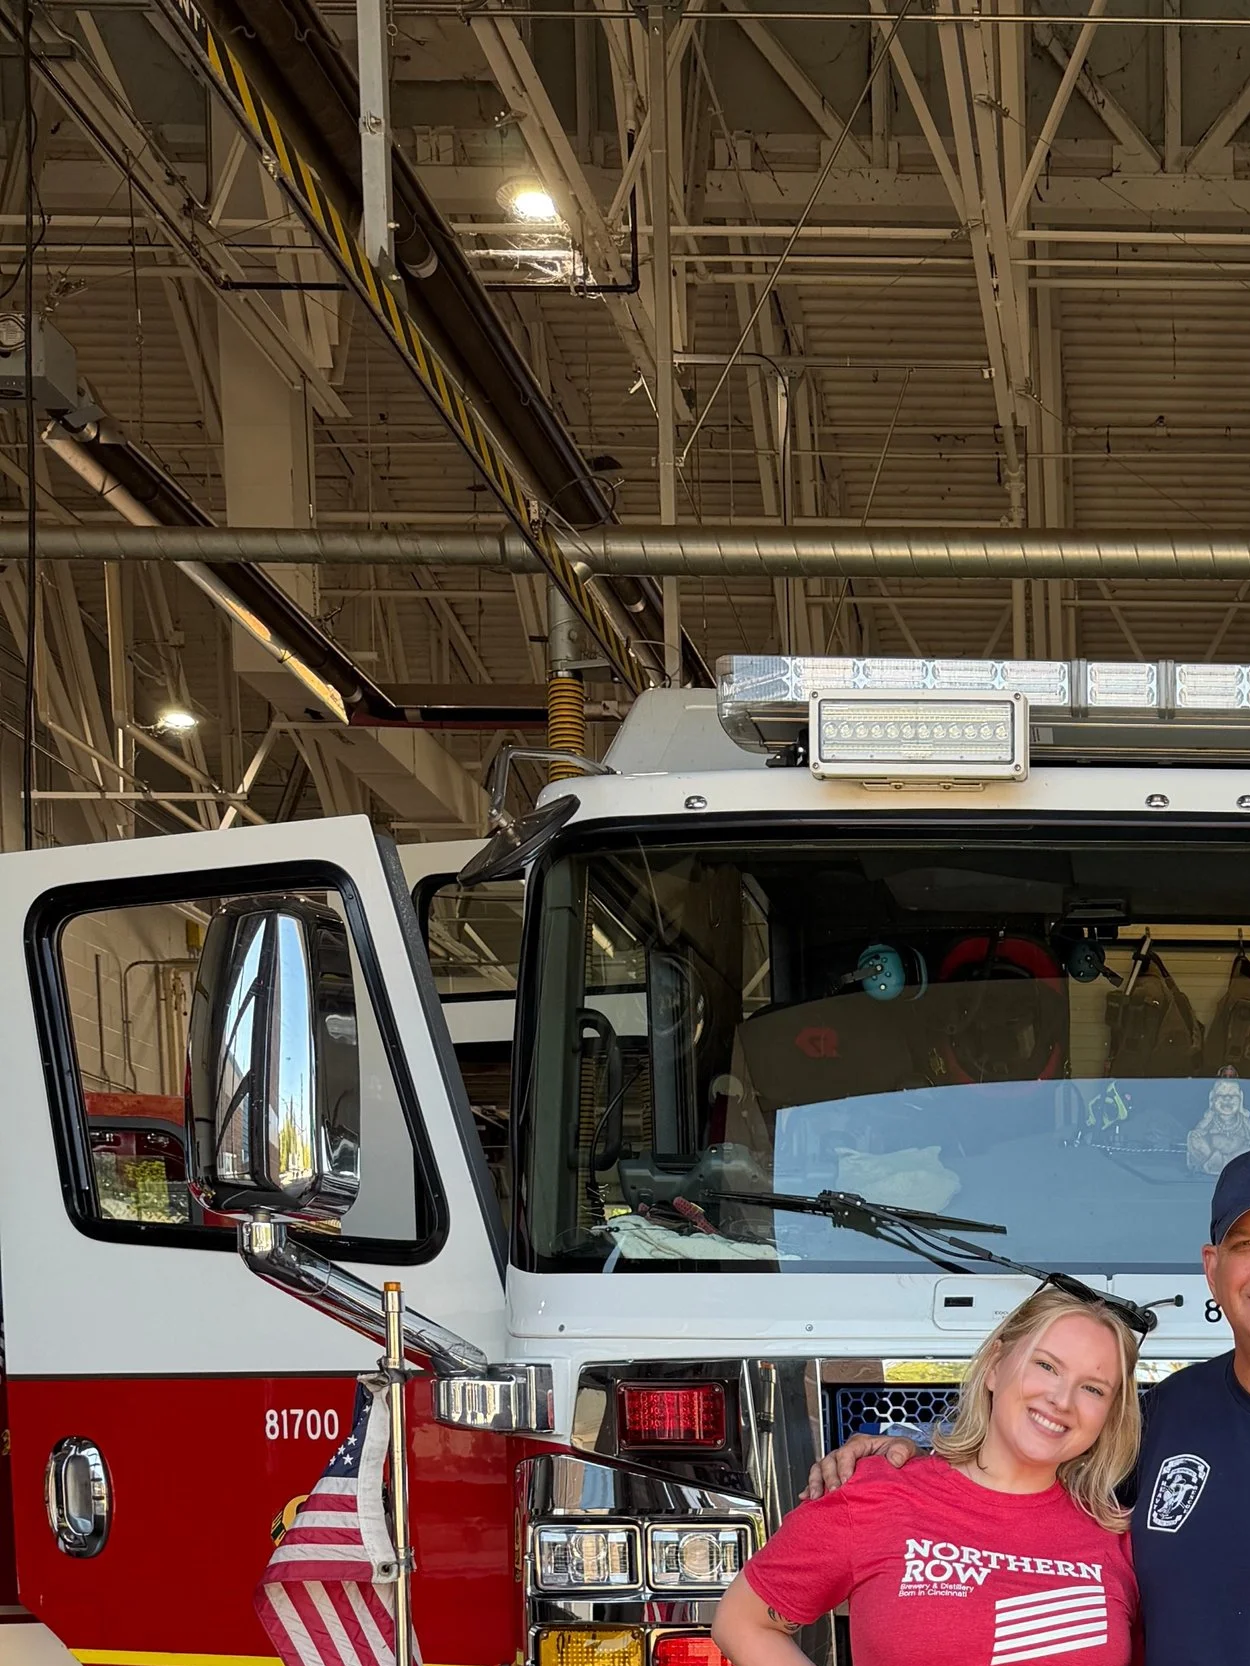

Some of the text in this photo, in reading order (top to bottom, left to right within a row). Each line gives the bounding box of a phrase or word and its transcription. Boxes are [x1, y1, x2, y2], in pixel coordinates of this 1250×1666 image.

[1204, 1298, 1222, 1323] 8
[265, 1408, 339, 1440] 81700
[901, 1559, 991, 1586] ROW
[904, 1538, 1103, 1583] NORTHERN
[900, 1583, 931, 1591] Brewery
[940, 1583, 975, 1593] Distillery
[927, 1589, 968, 1598] Cincinnati
